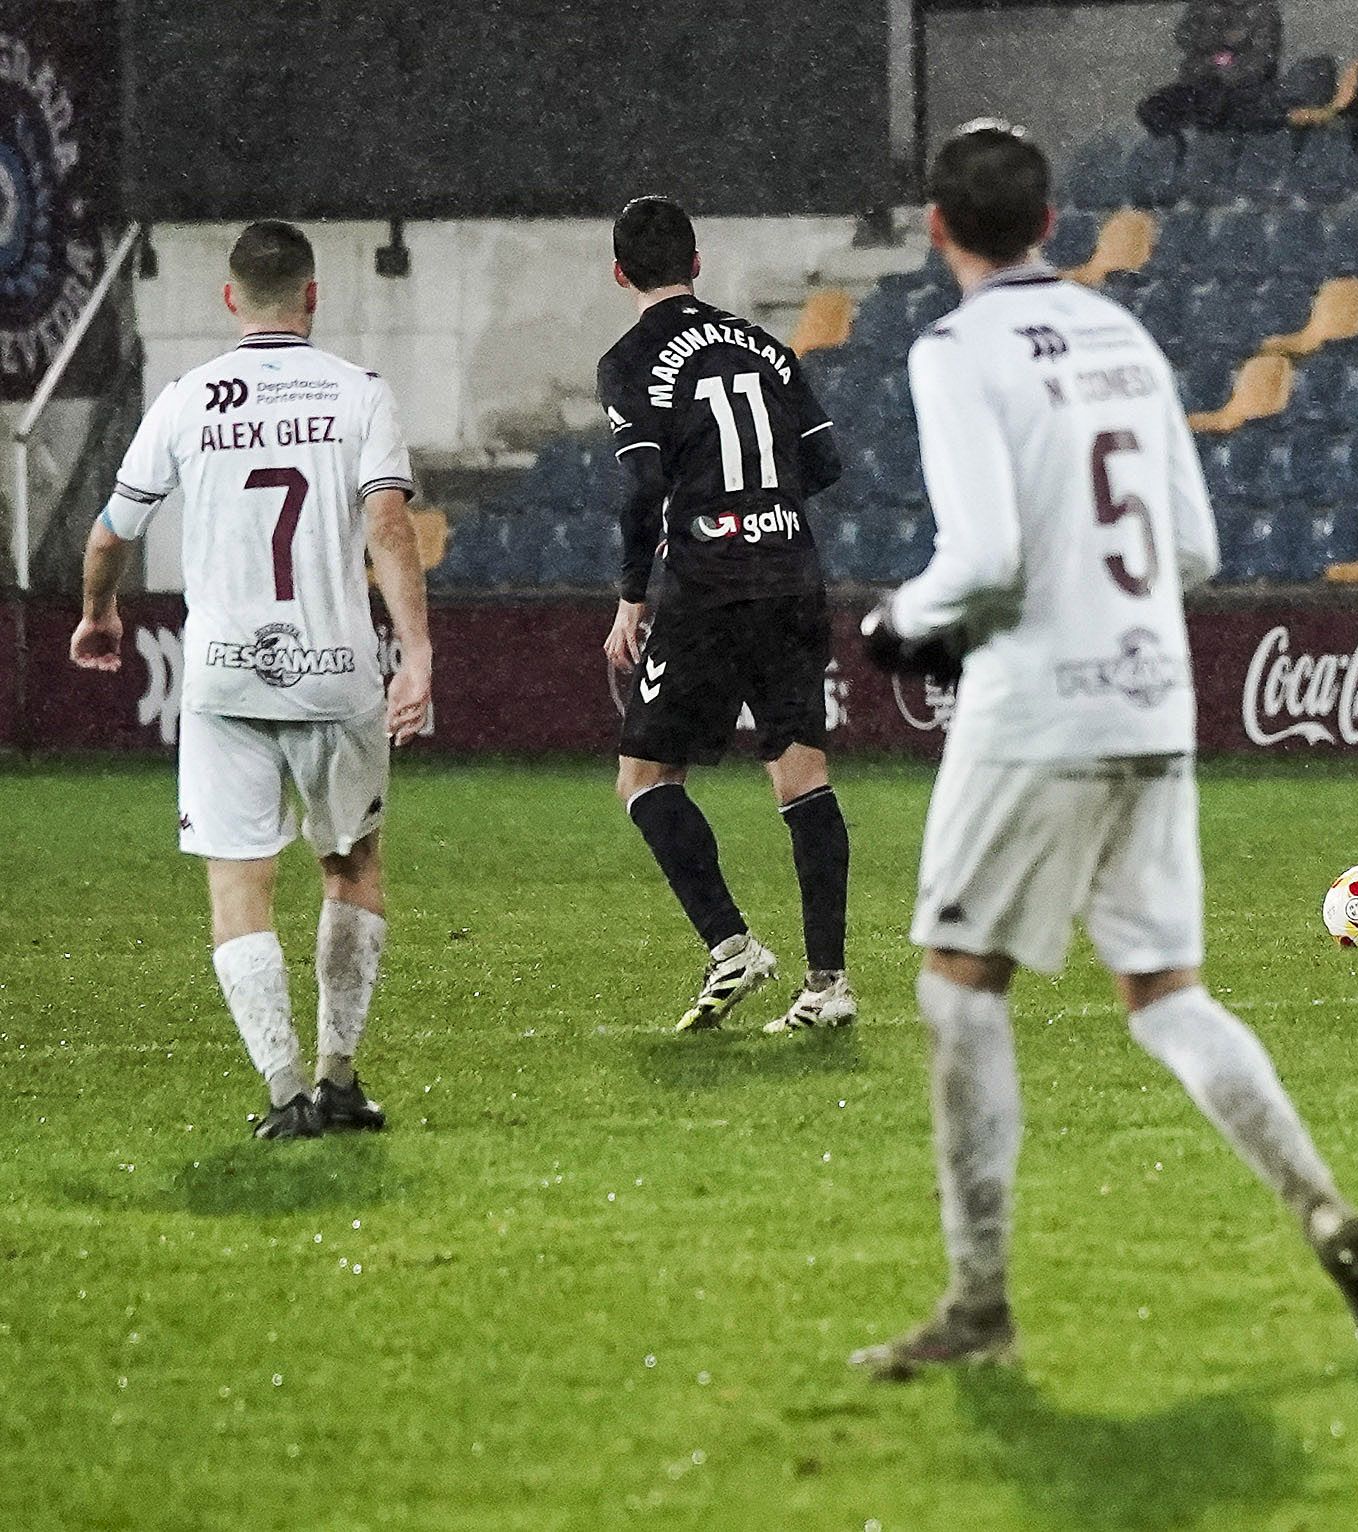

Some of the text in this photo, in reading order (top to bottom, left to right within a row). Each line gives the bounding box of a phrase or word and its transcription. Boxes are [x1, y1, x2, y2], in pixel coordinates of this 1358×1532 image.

[648, 323, 791, 408] MAGUNAZELAIA
[201, 416, 343, 451] ALEX GLEZ.
[694, 372, 778, 491] 11
[244, 467, 309, 601] 7
[743, 504, 800, 543] galys
[1091, 430, 1158, 597] 5
[206, 641, 355, 674] PESCAMAR
